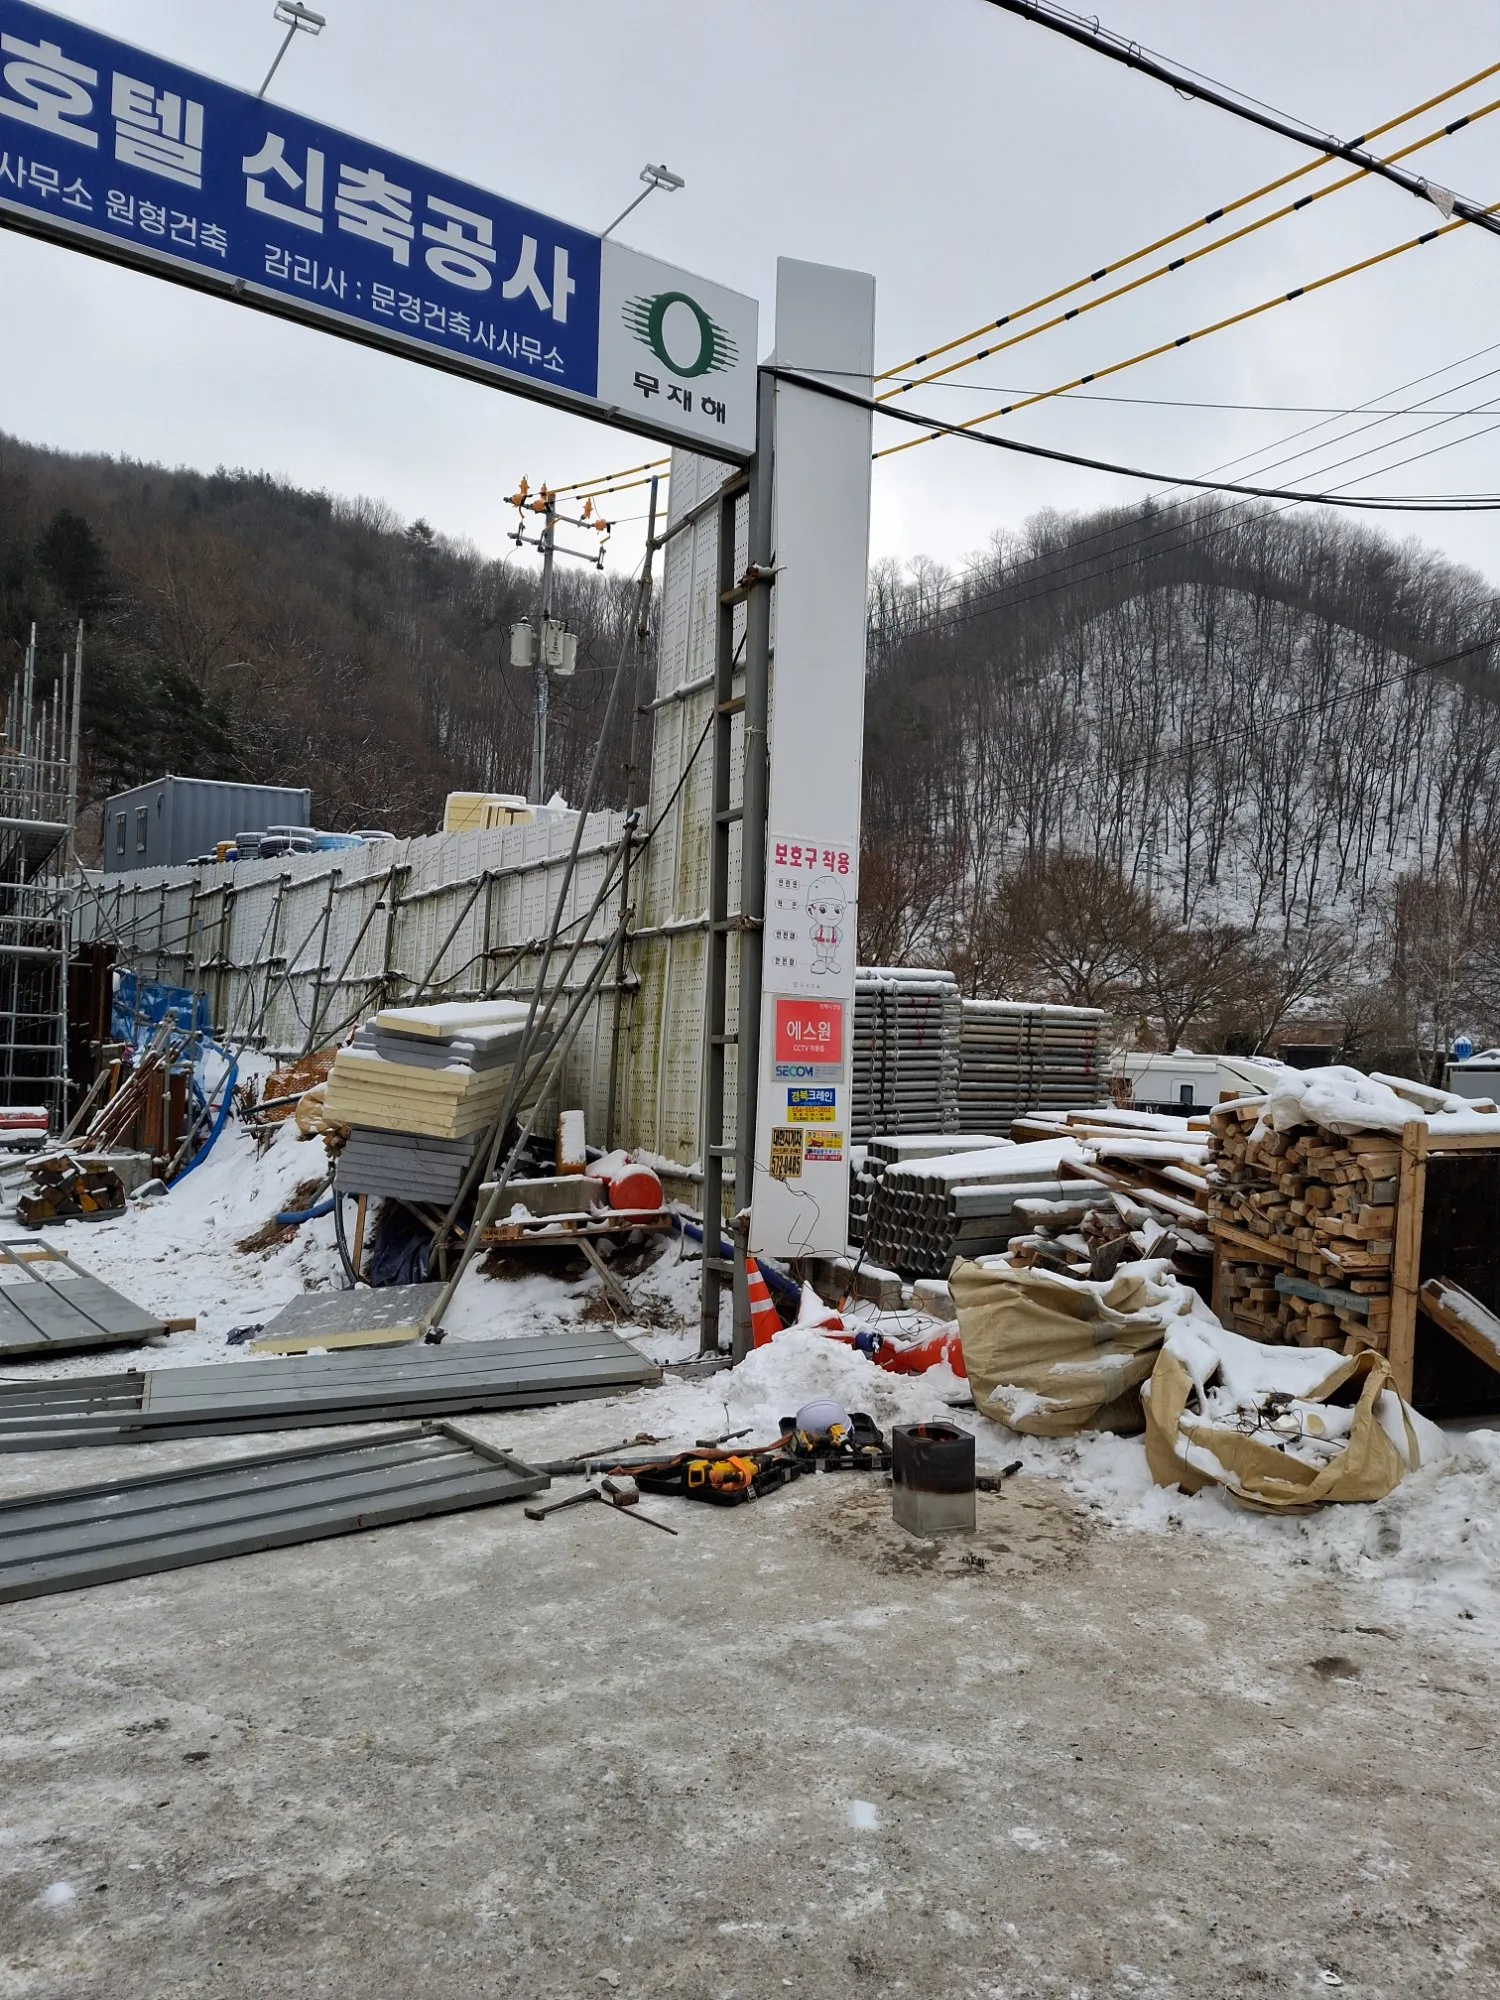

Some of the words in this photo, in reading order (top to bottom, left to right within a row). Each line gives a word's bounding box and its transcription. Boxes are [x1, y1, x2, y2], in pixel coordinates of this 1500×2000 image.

[0, 32, 204, 190] 호텔
[242, 131, 576, 324] 신축공사
[105, 189, 228, 258] 원형건축
[264, 244, 348, 299] 감리사
[371, 281, 565, 374] 문경건축사사무소
[633, 371, 726, 424] 무재해
[775, 843, 818, 869] 보호구
[822, 850, 850, 875] 착용
[786, 1020, 831, 1042] 에스원
[793, 1044, 809, 1053] CCTV
[776, 1065, 814, 1078] SECOM
[791, 1090, 833, 1103] 경북크레인
